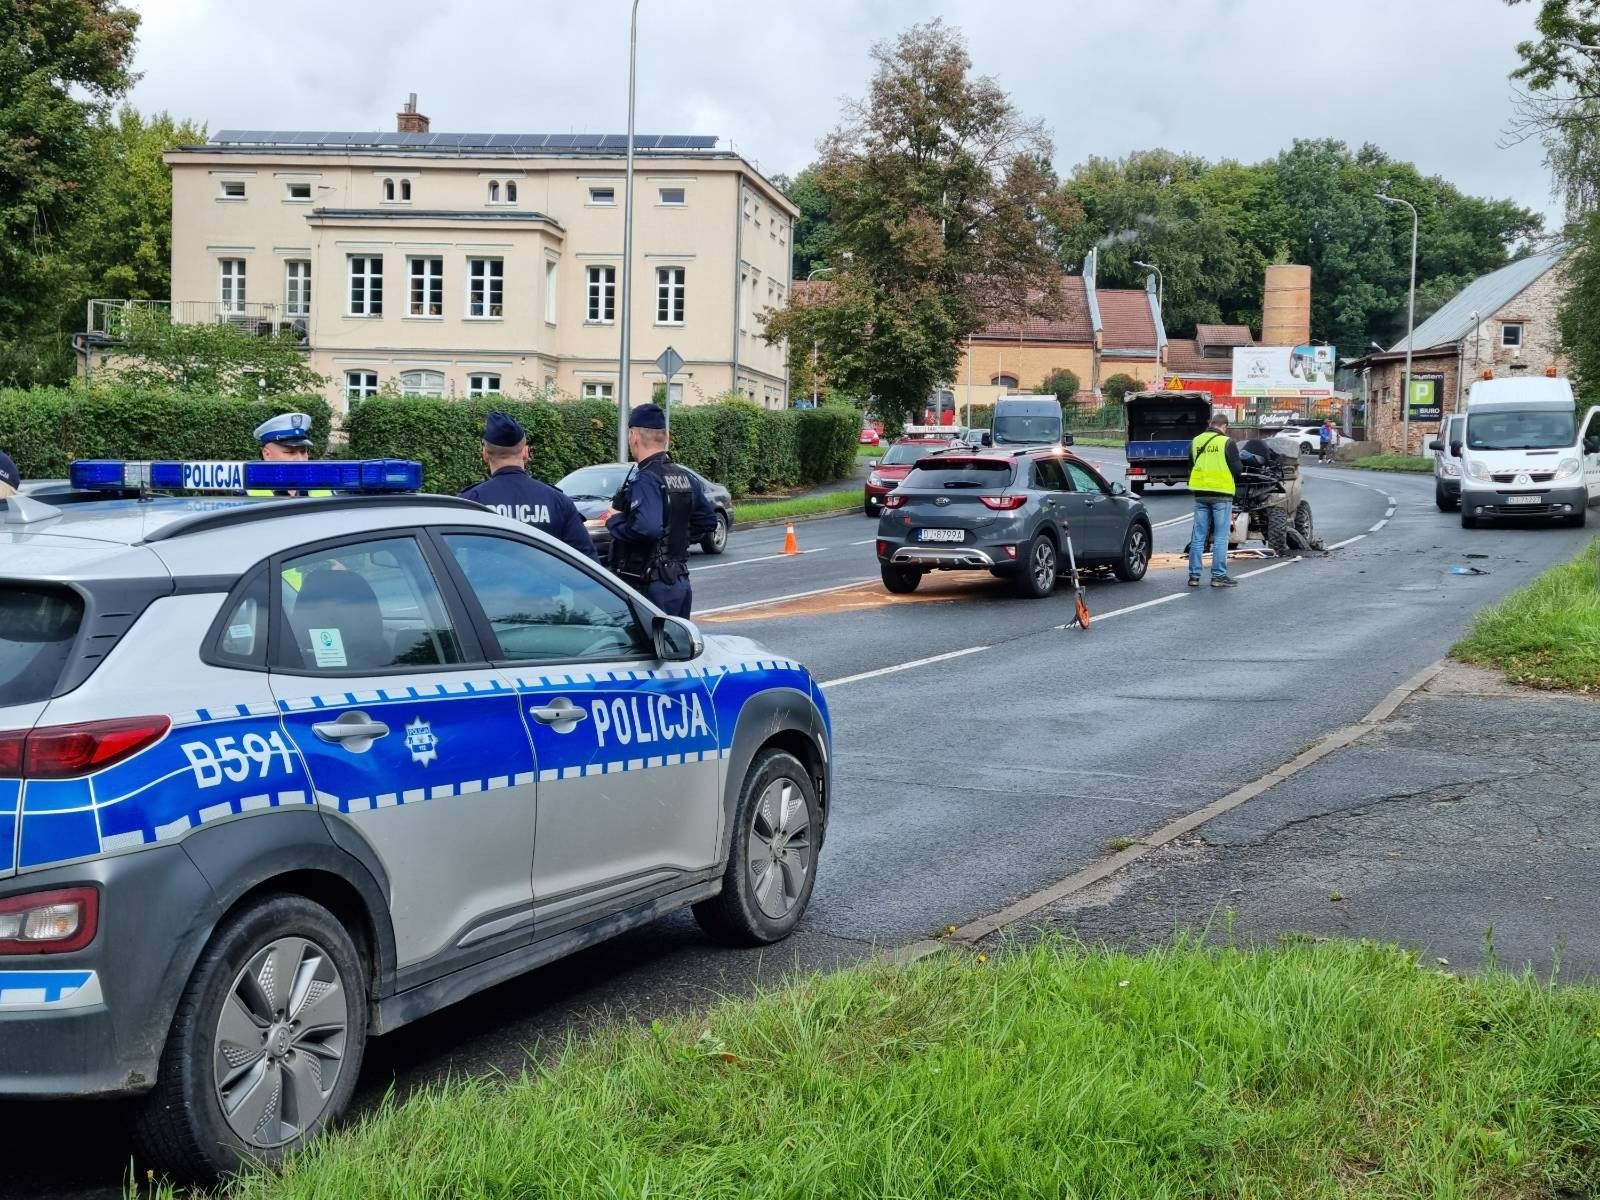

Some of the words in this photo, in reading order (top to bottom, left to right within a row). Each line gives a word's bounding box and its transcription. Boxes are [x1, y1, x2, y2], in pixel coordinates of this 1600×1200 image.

[183, 464, 242, 488] POLICJA
[936, 530, 962, 541] 8799A
[591, 692, 708, 747] POLICJA
[180, 730, 293, 789] B591
